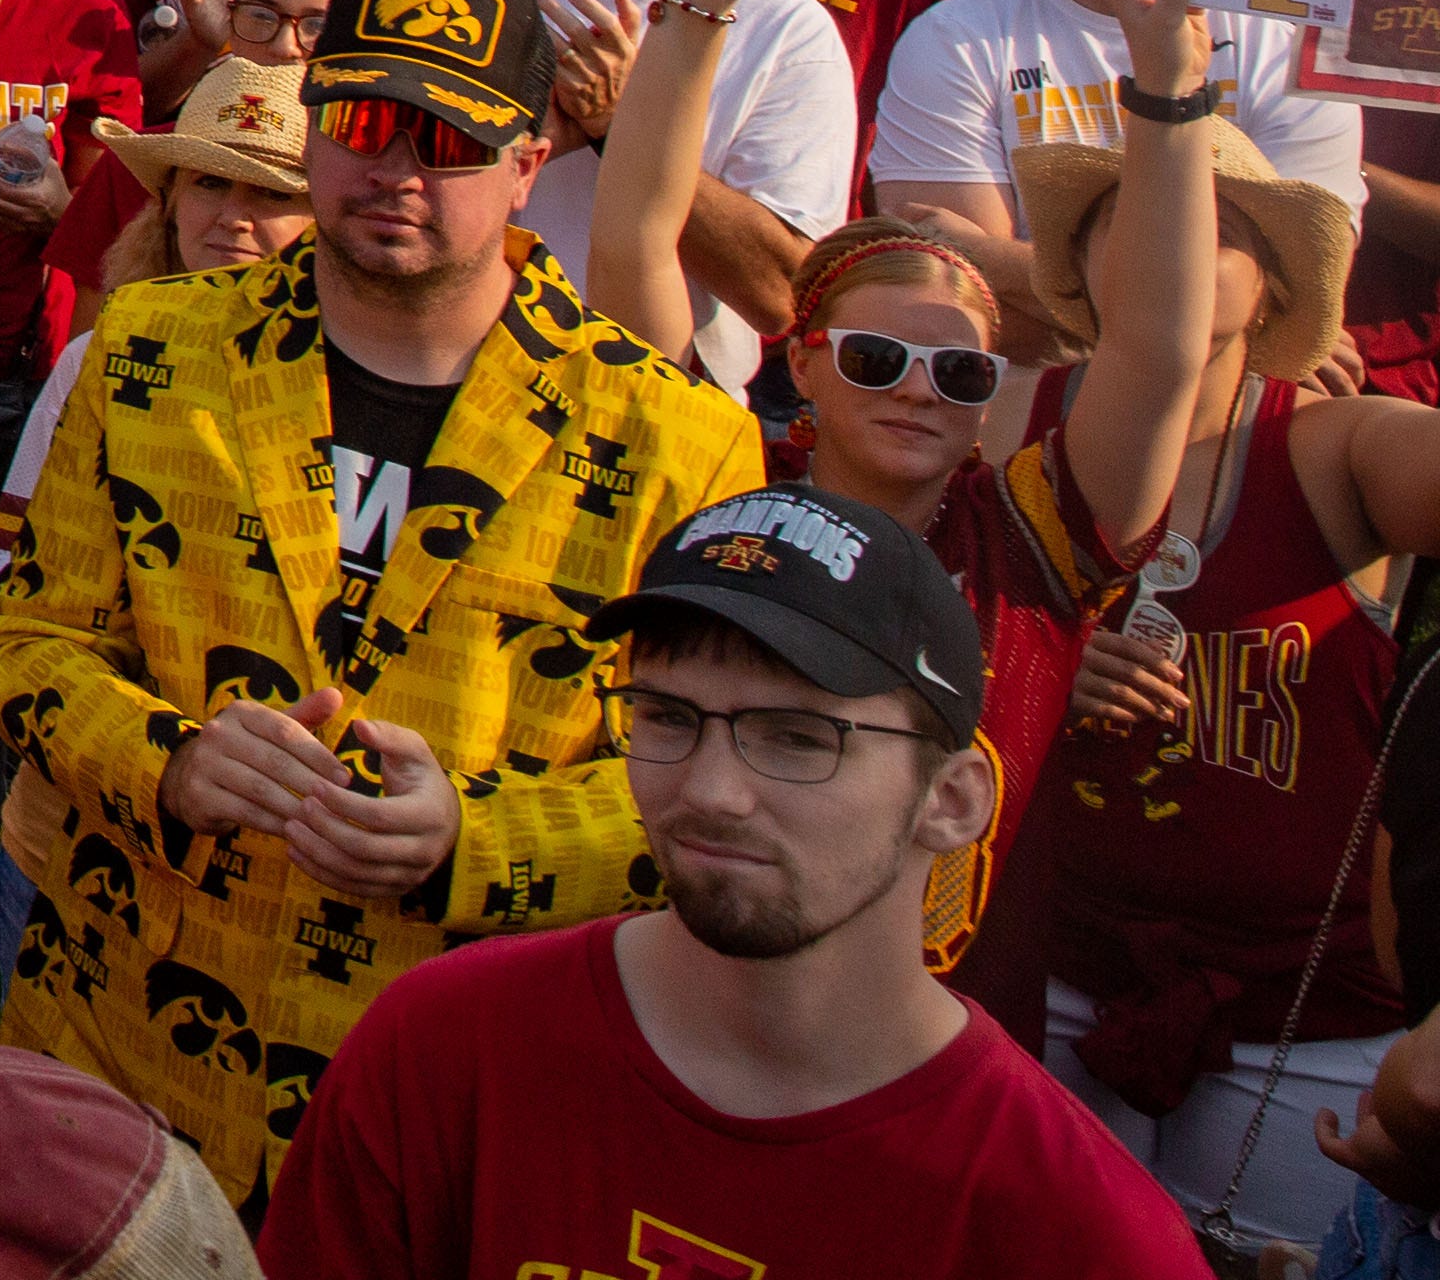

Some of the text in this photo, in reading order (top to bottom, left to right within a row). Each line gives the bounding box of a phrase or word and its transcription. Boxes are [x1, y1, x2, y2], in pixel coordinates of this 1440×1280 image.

[217, 103, 286, 131] STATE
[107, 355, 171, 387] IOWA
[566, 454, 637, 494] IOWA
[675, 499, 865, 583] CHAMPIONS
[701, 544, 780, 575] STATE
[298, 917, 375, 963] IOWA
[67, 939, 109, 988] IOWA
